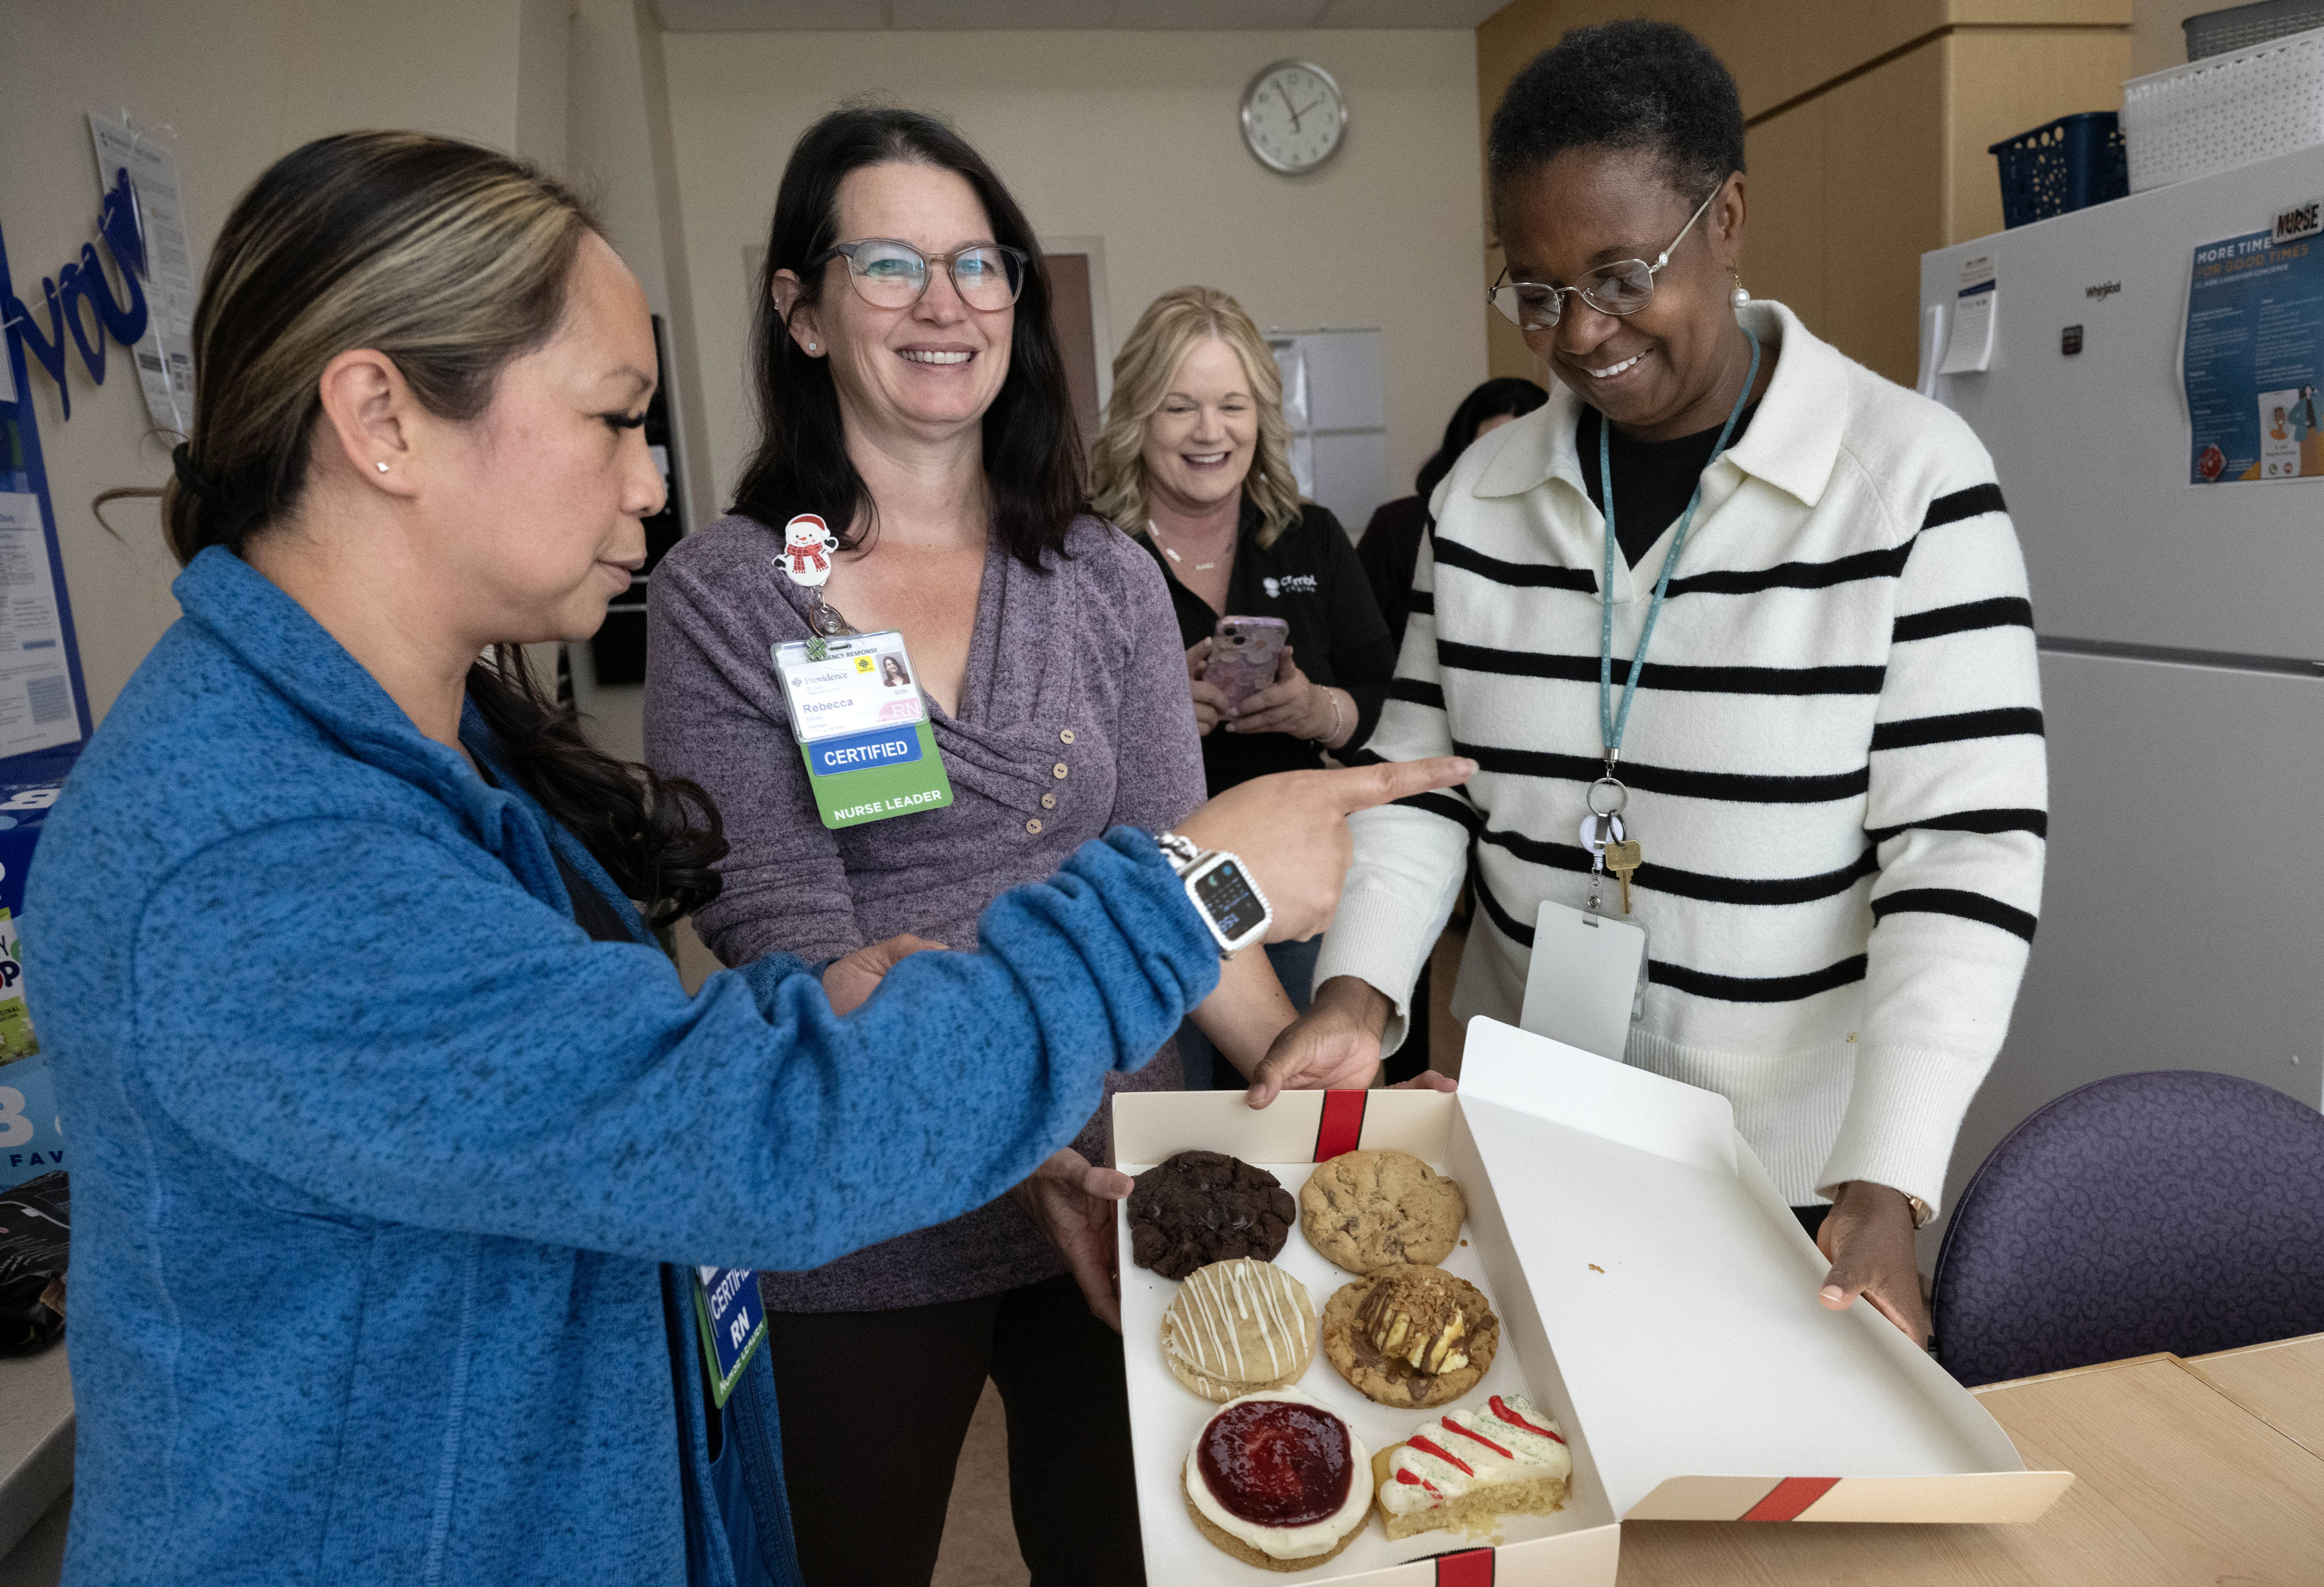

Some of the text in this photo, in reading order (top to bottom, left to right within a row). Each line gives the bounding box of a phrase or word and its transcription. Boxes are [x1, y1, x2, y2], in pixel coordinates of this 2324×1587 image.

[2276, 204, 2320, 237] NURSE
[2196, 244, 2309, 277] FOR GOOD TIMES
[2197, 237, 2272, 264] MORE TIME
[847, 648, 878, 657] RESPONSE
[804, 673, 848, 684] Providence
[802, 699, 854, 714] Rebecca
[891, 701, 920, 718] RN
[824, 741, 908, 766] CERTIFIED
[833, 789, 942, 821] NURSE LEADER
[730, 1306, 750, 1350] RN
